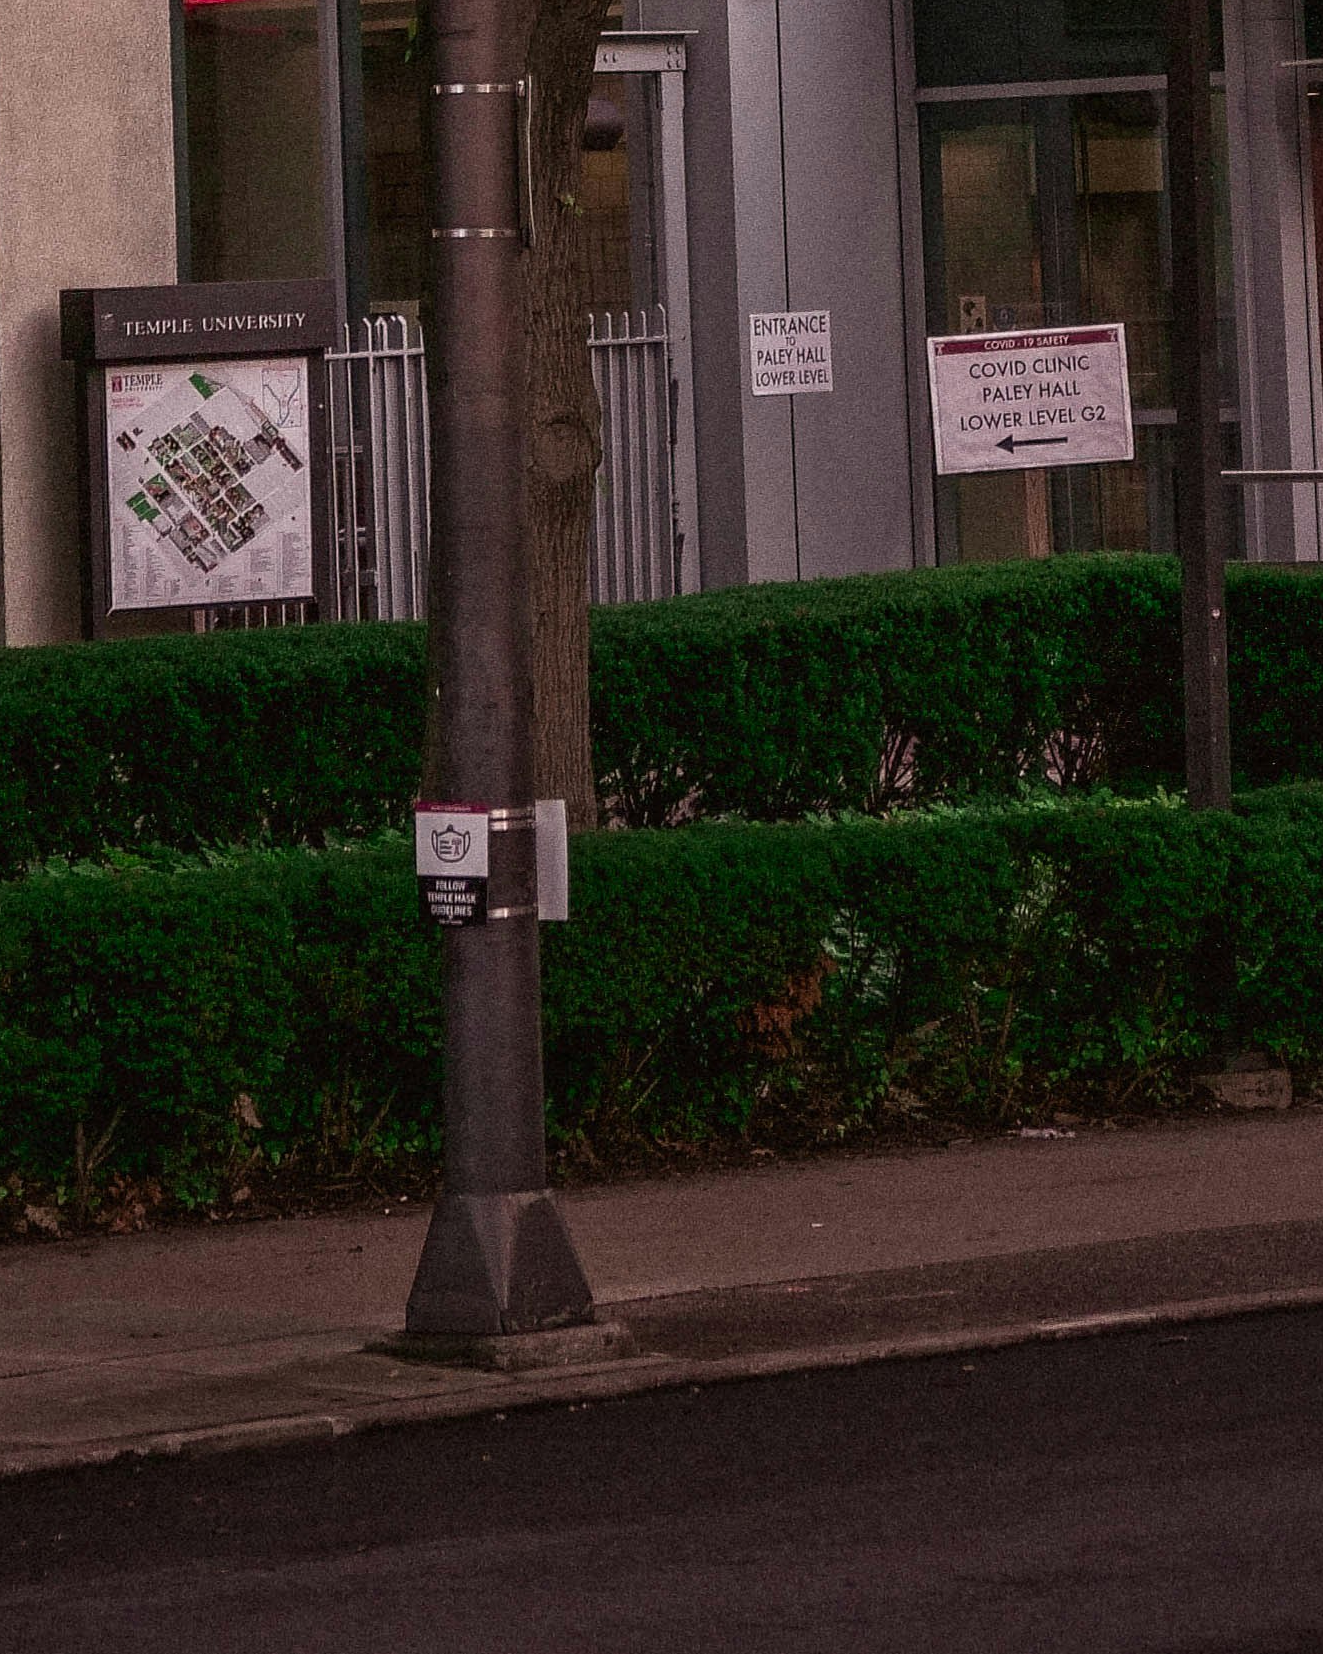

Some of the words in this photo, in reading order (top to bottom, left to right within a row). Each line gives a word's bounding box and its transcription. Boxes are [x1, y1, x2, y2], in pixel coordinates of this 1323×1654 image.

[123, 318, 194, 336] TEMPLE
[201, 313, 306, 332] UNIVERSITY
[753, 315, 826, 336] ENTRANCE
[785, 336, 796, 346] TO
[984, 340, 1015, 350] COVID
[1023, 338, 1034, 348] 19
[1037, 335, 1070, 347] SAFETY
[757, 348, 793, 366] PALEY
[797, 346, 826, 364] HALL
[969, 360, 1026, 379] COVID
[1033, 355, 1090, 374] CLINIC
[124, 374, 163, 386] TEMPLE
[756, 371, 795, 387] LOWER
[799, 369, 829, 384] LEVEL
[983, 384, 1033, 403] PALEY
[1039, 381, 1080, 398] HALL
[961, 412, 1022, 431] LOWER
[1029, 408, 1076, 425] LEVEL
[1081, 405, 1105, 422] G2
